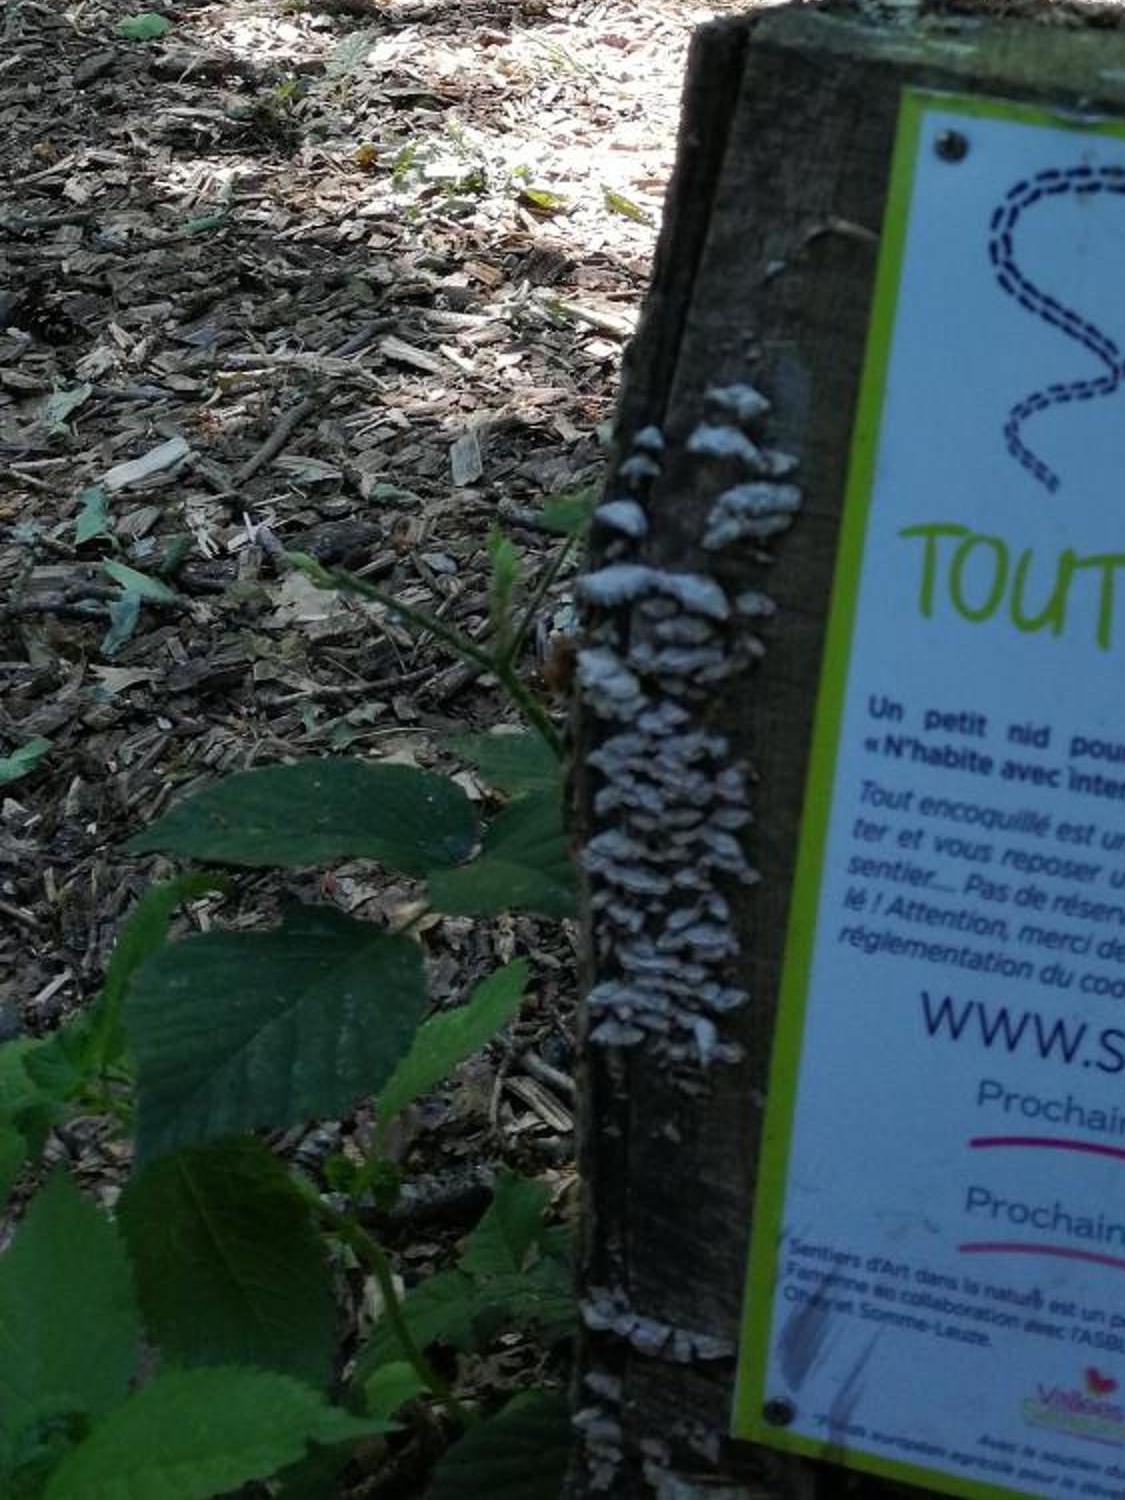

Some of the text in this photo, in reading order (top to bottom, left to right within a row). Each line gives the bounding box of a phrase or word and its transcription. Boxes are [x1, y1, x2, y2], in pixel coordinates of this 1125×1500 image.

[867, 694, 905, 723] Un
[923, 709, 988, 738] petit
[1006, 722, 1052, 750] nid
[999, 759, 1062, 789] avec
[859, 779, 915, 813] Tout
[917, 796, 1052, 839] encoquillé
[1054, 821, 1097, 847] est
[852, 817, 890, 843] ter
[896, 828, 926, 851] et
[933, 835, 995, 865] vous
[1000, 847, 1104, 883] reposer
[962, 872, 1011, 904] Pas
[1012, 883, 1049, 912] de
[842, 886, 868, 912] lé
[883, 895, 1010, 944] Attention,
[1016, 924, 1094, 956] merci
[1038, 961, 1076, 990] du
